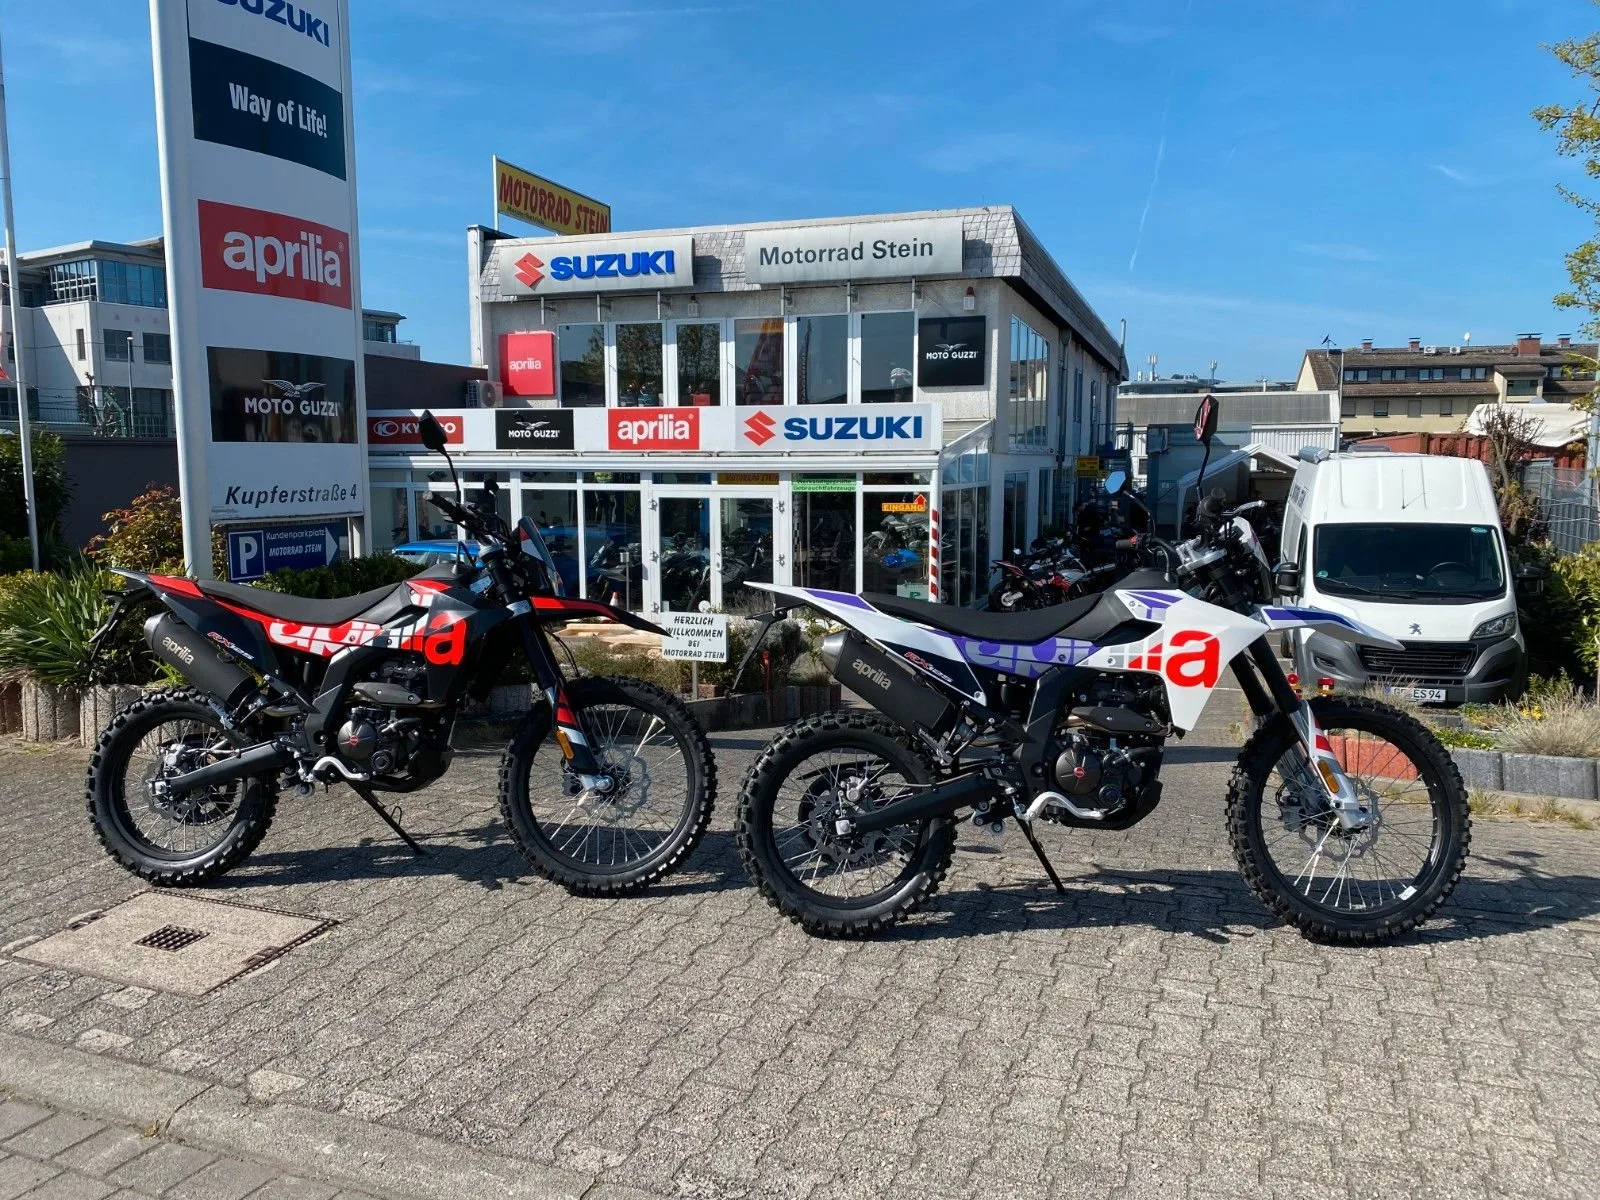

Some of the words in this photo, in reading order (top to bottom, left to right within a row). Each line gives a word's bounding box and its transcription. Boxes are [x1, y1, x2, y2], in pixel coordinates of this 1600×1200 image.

[217, 0, 329, 47] UZUKI
[229, 82, 271, 122] Way
[277, 101, 294, 125] of
[299, 104, 327, 138] Life!
[499, 172, 572, 226] MOTORRAD
[575, 203, 608, 233] STEIN
[223, 231, 341, 287] aprilia
[759, 244, 864, 266] Motorrad
[872, 238, 934, 259] Stein
[550, 251, 675, 280] SUZUKI
[509, 357, 542, 372] aprilia
[926, 352, 949, 360] MOTO
[951, 351, 977, 359] GUZZI
[244, 397, 294, 415] MOTO
[300, 400, 338, 417] GUZZI
[401, 422, 456, 434] KYO
[508, 429, 531, 438] MOTO
[533, 429, 558, 438] GUZZI
[617, 413, 690, 441] aprilia
[784, 416, 922, 440] SUZUKI
[225, 483, 347, 508] Kupferstraße
[350, 484, 357, 500] 4
[266, 529, 325, 541] Kundenparkplatz
[238, 536, 258, 575] P
[269, 546, 303, 557] MOTORRAD
[674, 616, 714, 626] HERZLICH
[665, 627, 723, 638] WILLKOMMEN
[163, 636, 194, 664] aprilia
[663, 649, 702, 658] MOTORRAD
[704, 651, 725, 659] STEIN
[688, 640, 700, 648] BEI
[852, 657, 892, 690] aprilia
[1413, 689, 1427, 699] ES
[1428, 690, 1442, 699] 94
